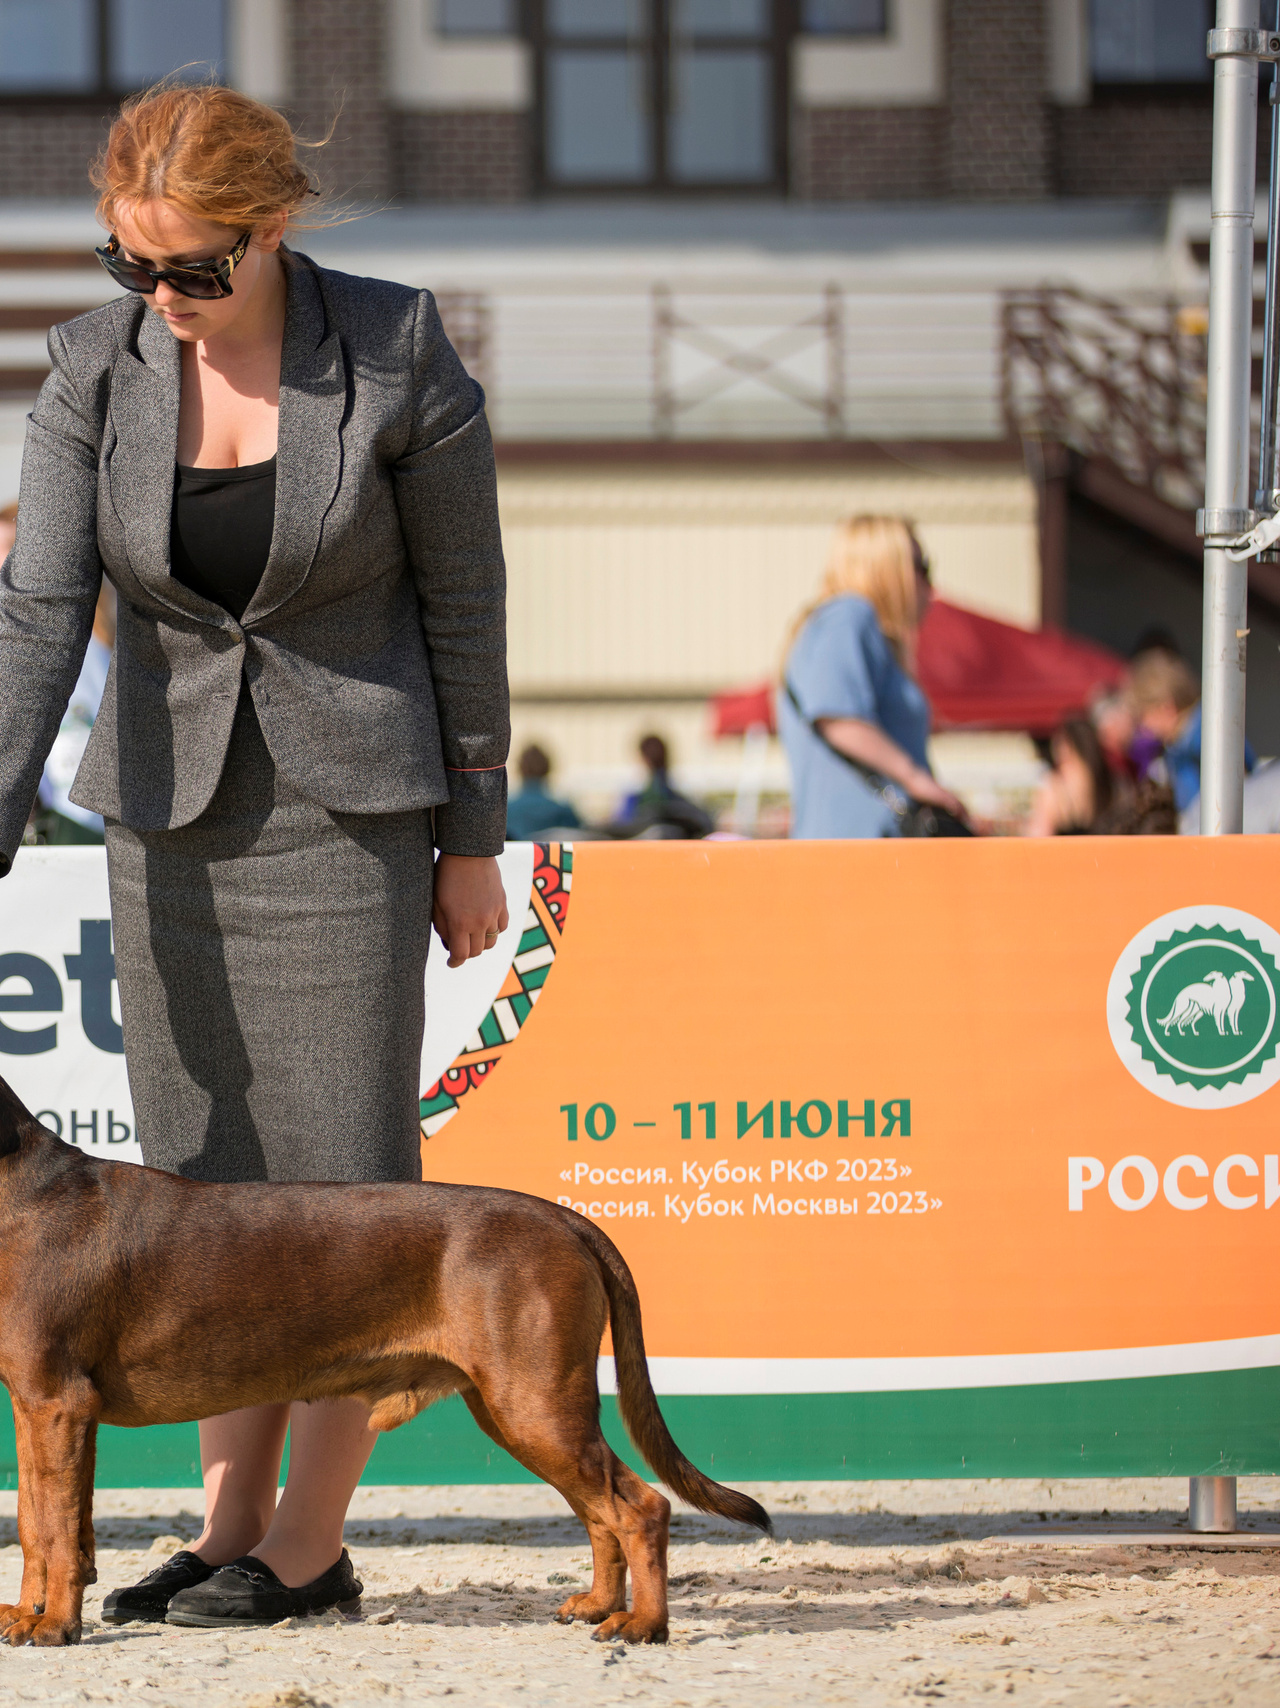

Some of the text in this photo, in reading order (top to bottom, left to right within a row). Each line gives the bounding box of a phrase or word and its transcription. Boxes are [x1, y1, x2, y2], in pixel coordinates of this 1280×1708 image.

[559, 1101, 617, 1142] 10
[673, 1100, 717, 1140] 11
[736, 1098, 912, 1140] ИЮНЯ
[559, 1157, 913, 1191] «Россия. Кубок РКФ 2023»
[664, 1192, 745, 1224] Кубок
[752, 1192, 858, 1216] Москвы
[866, 1190, 943, 1214] 2023»
